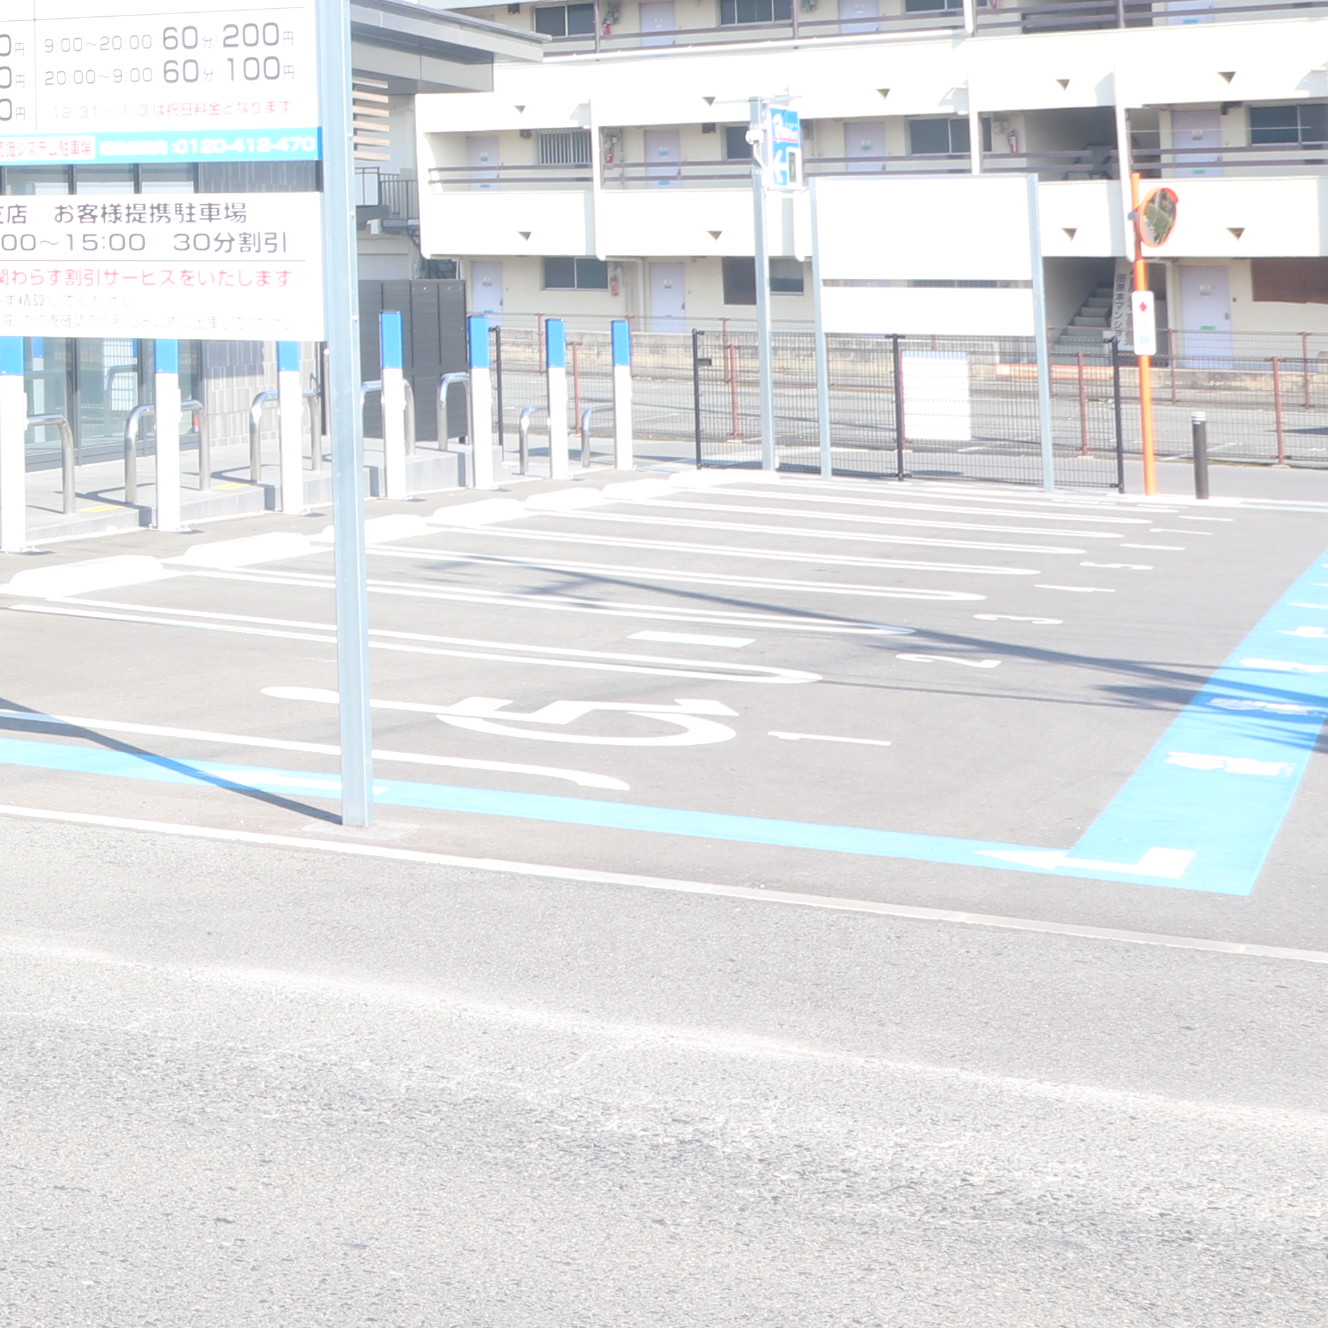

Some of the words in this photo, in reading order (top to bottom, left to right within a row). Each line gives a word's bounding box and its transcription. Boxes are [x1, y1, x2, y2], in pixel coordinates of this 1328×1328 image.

[54, 202, 247, 224] お客様提携駐車場
[173, 231, 287, 253] 30分割引
